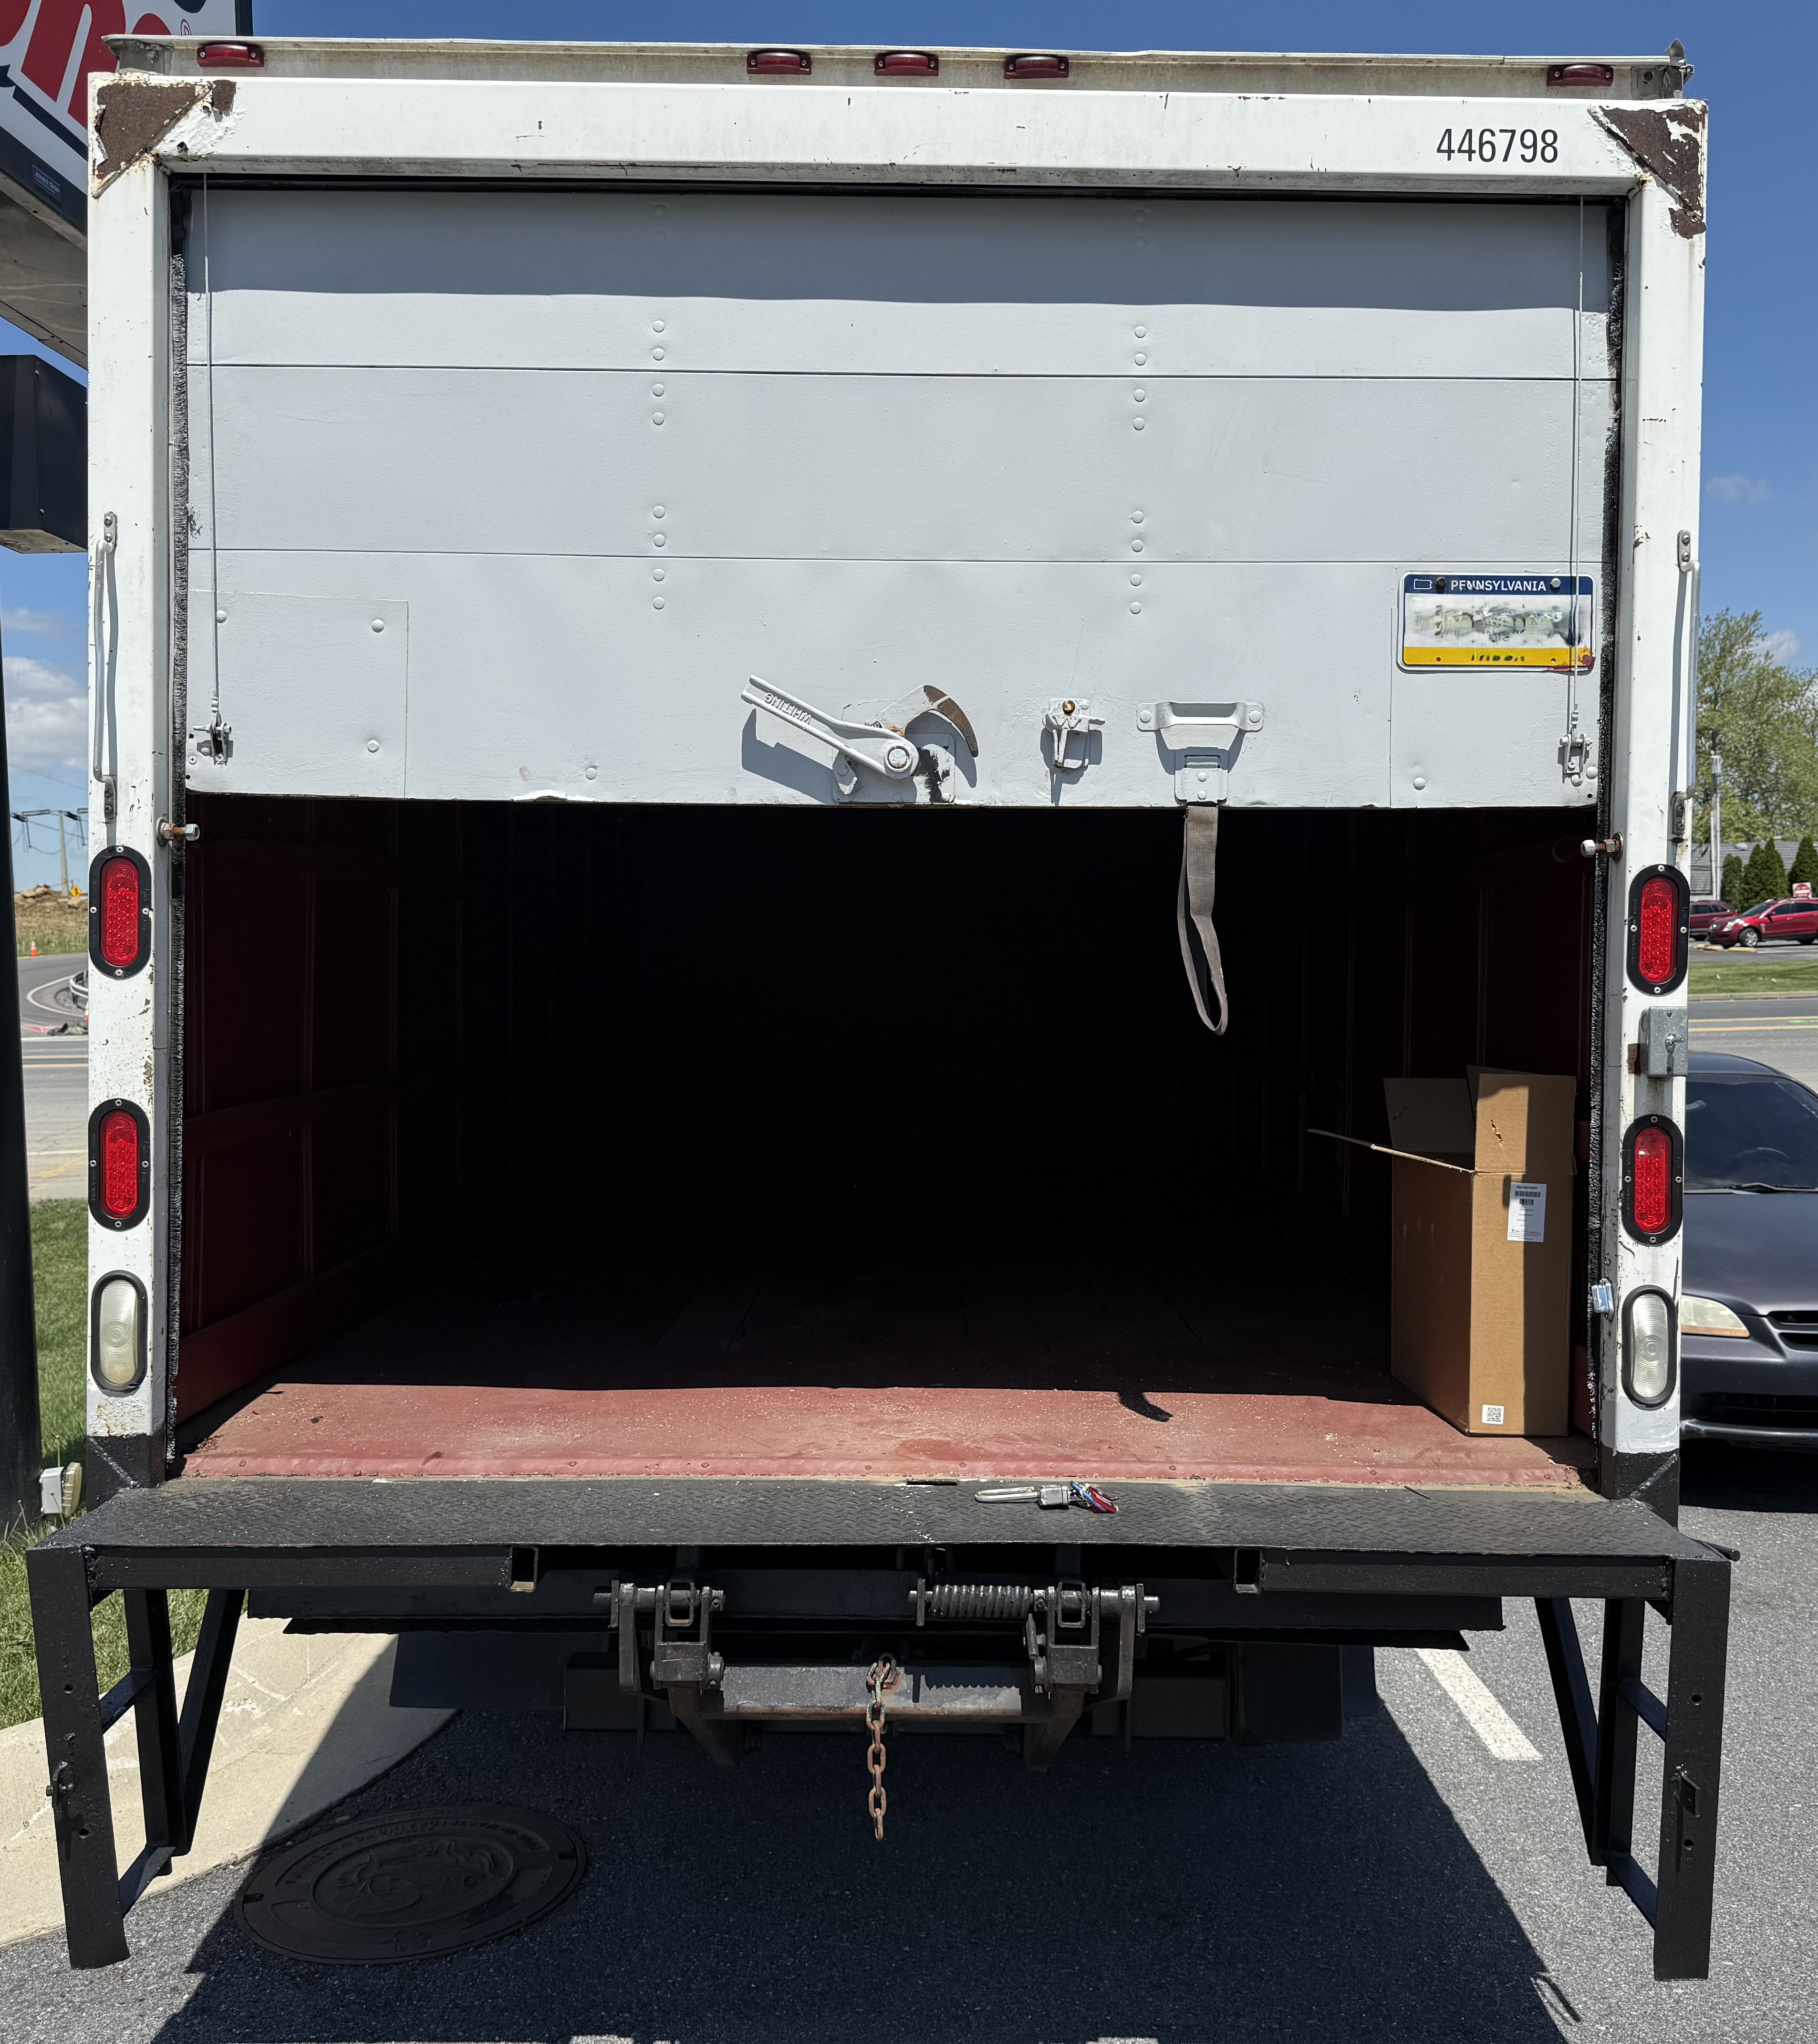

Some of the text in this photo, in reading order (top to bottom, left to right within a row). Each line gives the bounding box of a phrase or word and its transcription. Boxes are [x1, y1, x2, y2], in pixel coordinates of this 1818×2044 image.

[1436, 128, 1558, 163] 446798
[1451, 580, 1547, 591] PENNSYLVANIA
[764, 693, 811, 725] WHITING
